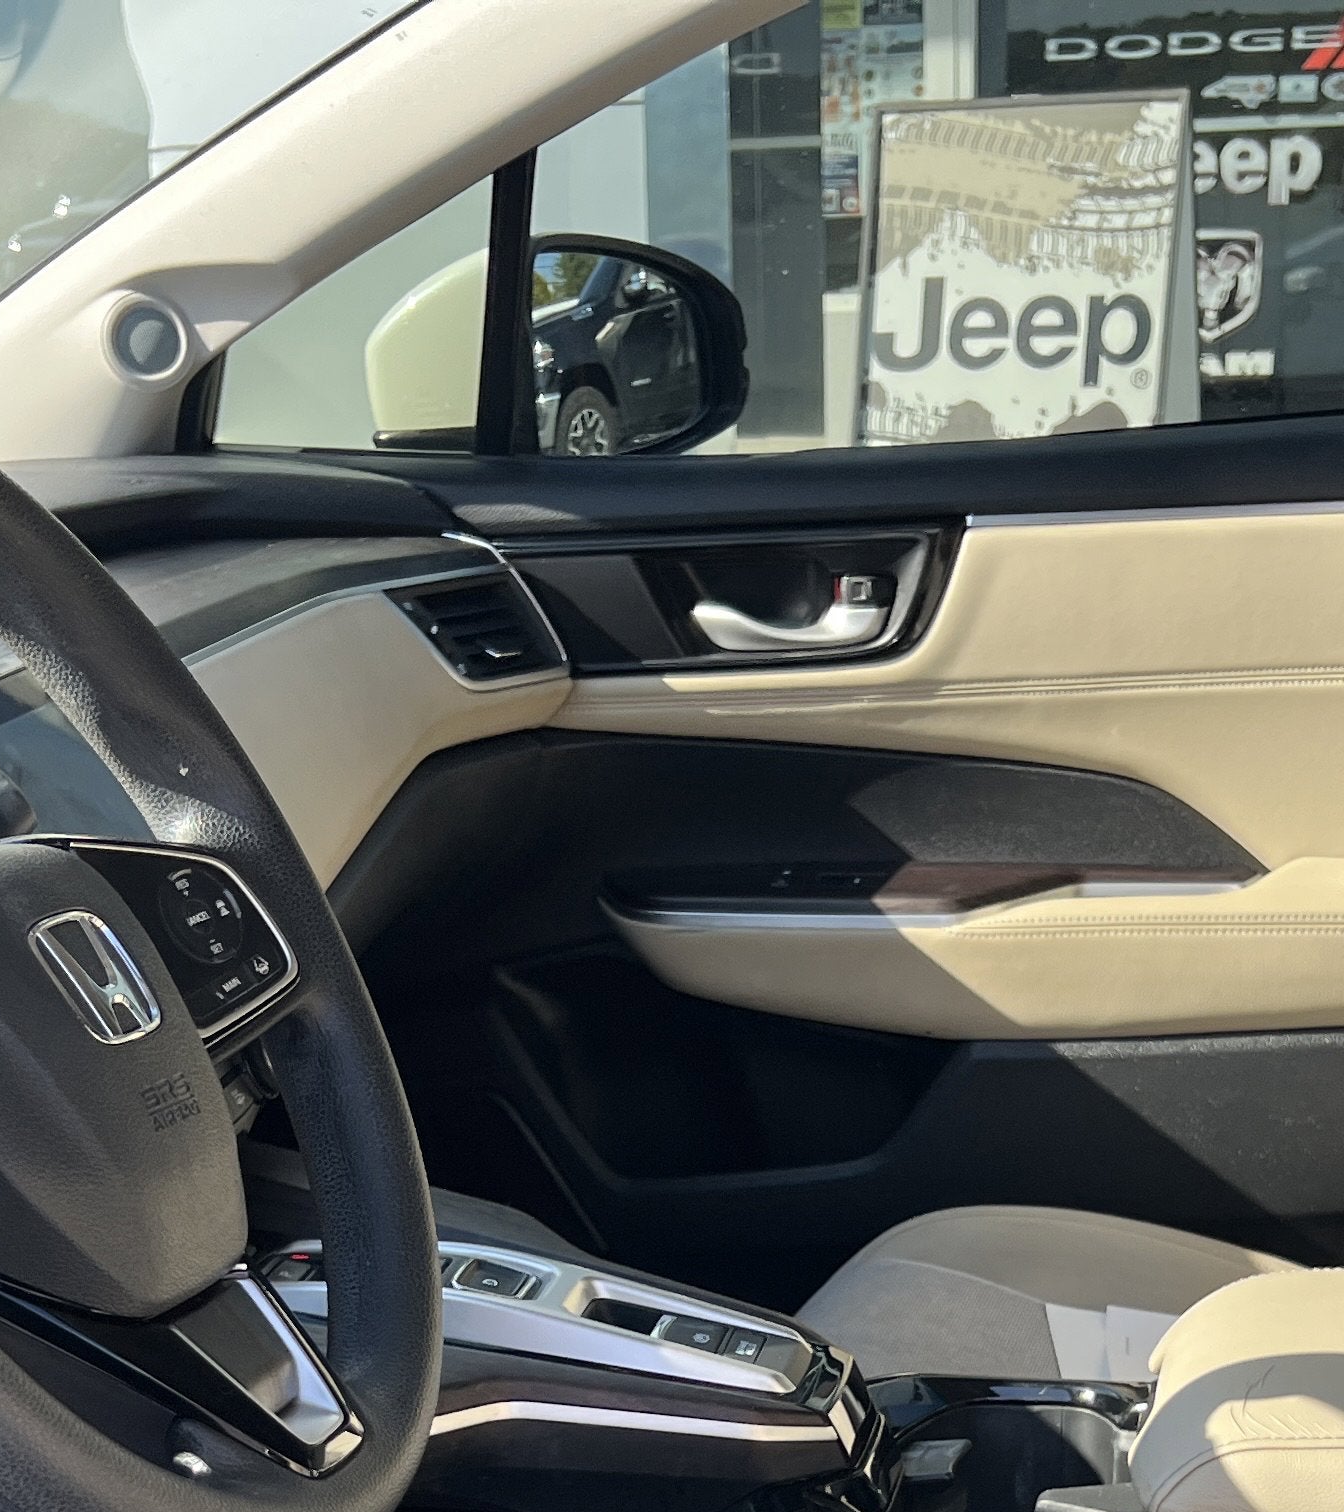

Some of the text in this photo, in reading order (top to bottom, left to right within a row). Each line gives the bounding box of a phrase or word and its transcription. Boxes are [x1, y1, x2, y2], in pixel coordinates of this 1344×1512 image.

[1193, 135, 1323, 206] eep
[872, 276, 1152, 389] Jeep
[1199, 350, 1276, 377] AM
